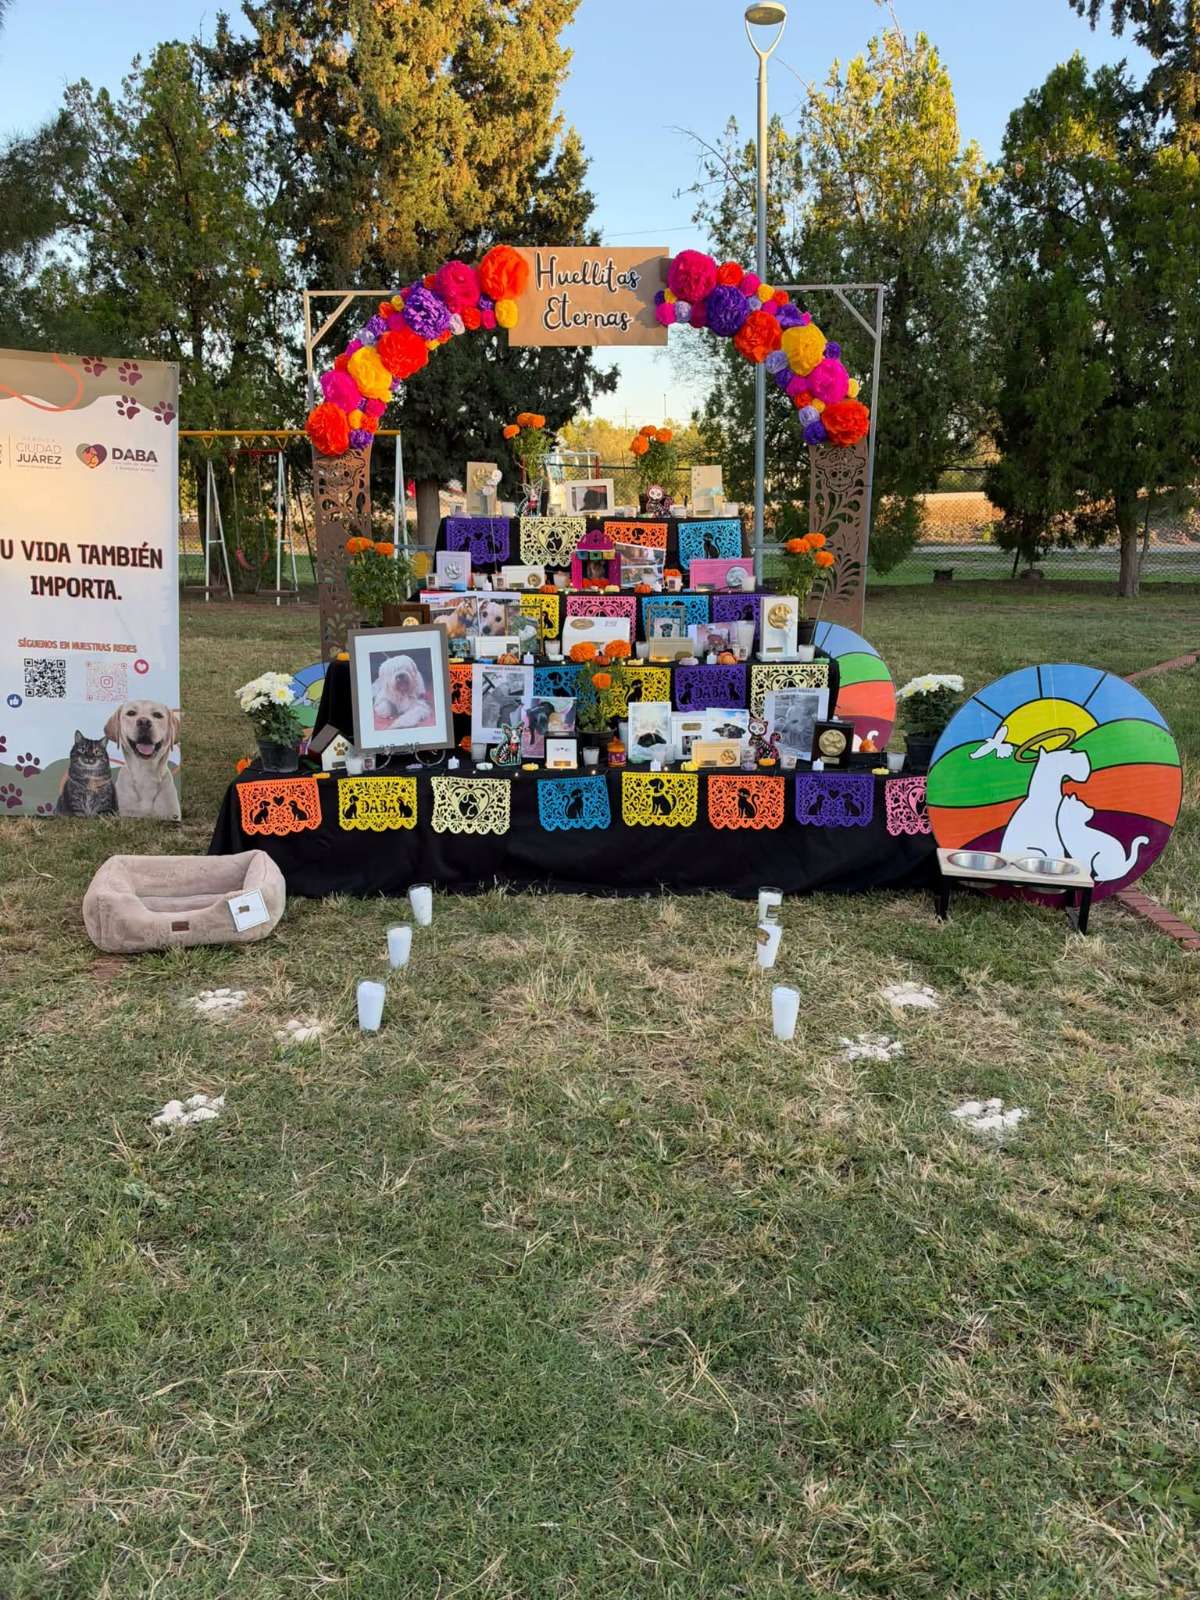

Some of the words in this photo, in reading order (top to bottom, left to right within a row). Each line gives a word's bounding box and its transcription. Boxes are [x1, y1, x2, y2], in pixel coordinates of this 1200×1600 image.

[536, 252, 640, 293] Huellitas
[544, 292, 631, 330] Eternas
[16, 442, 62, 454] CIUDAD
[111, 447, 158, 463] DABA
[17, 452, 62, 465] JUÁREZ
[21, 540, 71, 563] VIDA
[77, 541, 163, 569] TAMBIÉN
[30, 575, 122, 600] IMPORTA.
[18, 637, 58, 649] SÍGUENOS
[59, 641, 71, 650] EN
[71, 641, 111, 652] NUESTRAS
[112, 643, 137, 654] REDES
[695, 686, 726, 698] DABA
[361, 799, 397, 813] DABA
